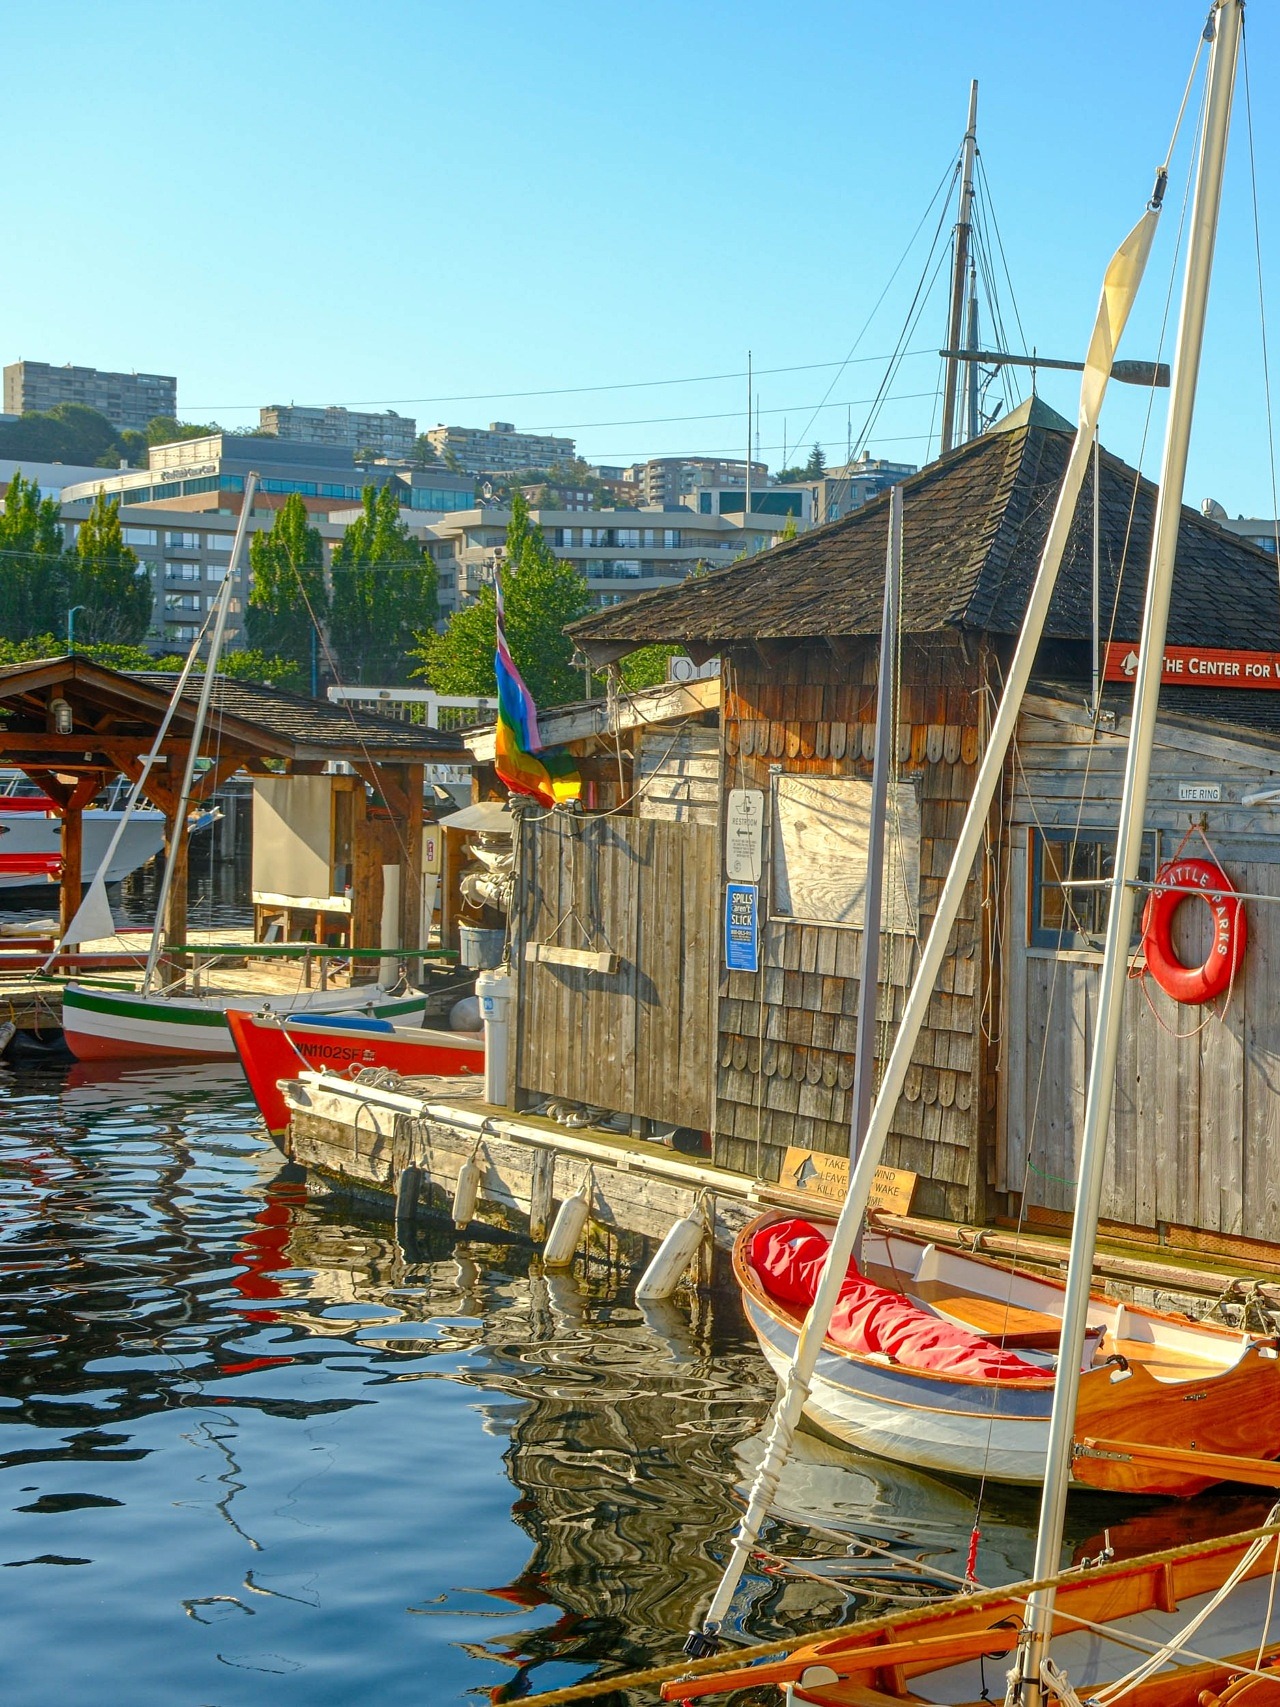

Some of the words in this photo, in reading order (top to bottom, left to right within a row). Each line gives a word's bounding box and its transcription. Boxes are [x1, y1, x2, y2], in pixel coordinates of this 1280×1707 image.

[1188, 658, 1240, 676] CENTER
[1245, 664, 1270, 678] FOR
[1180, 789, 1197, 799] LIFE
[1199, 789, 1219, 799] RING
[732, 893, 753, 905] SPILLS
[1154, 866, 1209, 899] SEATTLE
[1211, 893, 1230, 956] PARKS
[731, 914, 752, 926] SLICK
[824, 1157, 847, 1171] TAKE
[816, 1183, 835, 1196] KILL
[819, 1171, 848, 1185] LEAVE
[875, 1183, 901, 1197] WAKE
